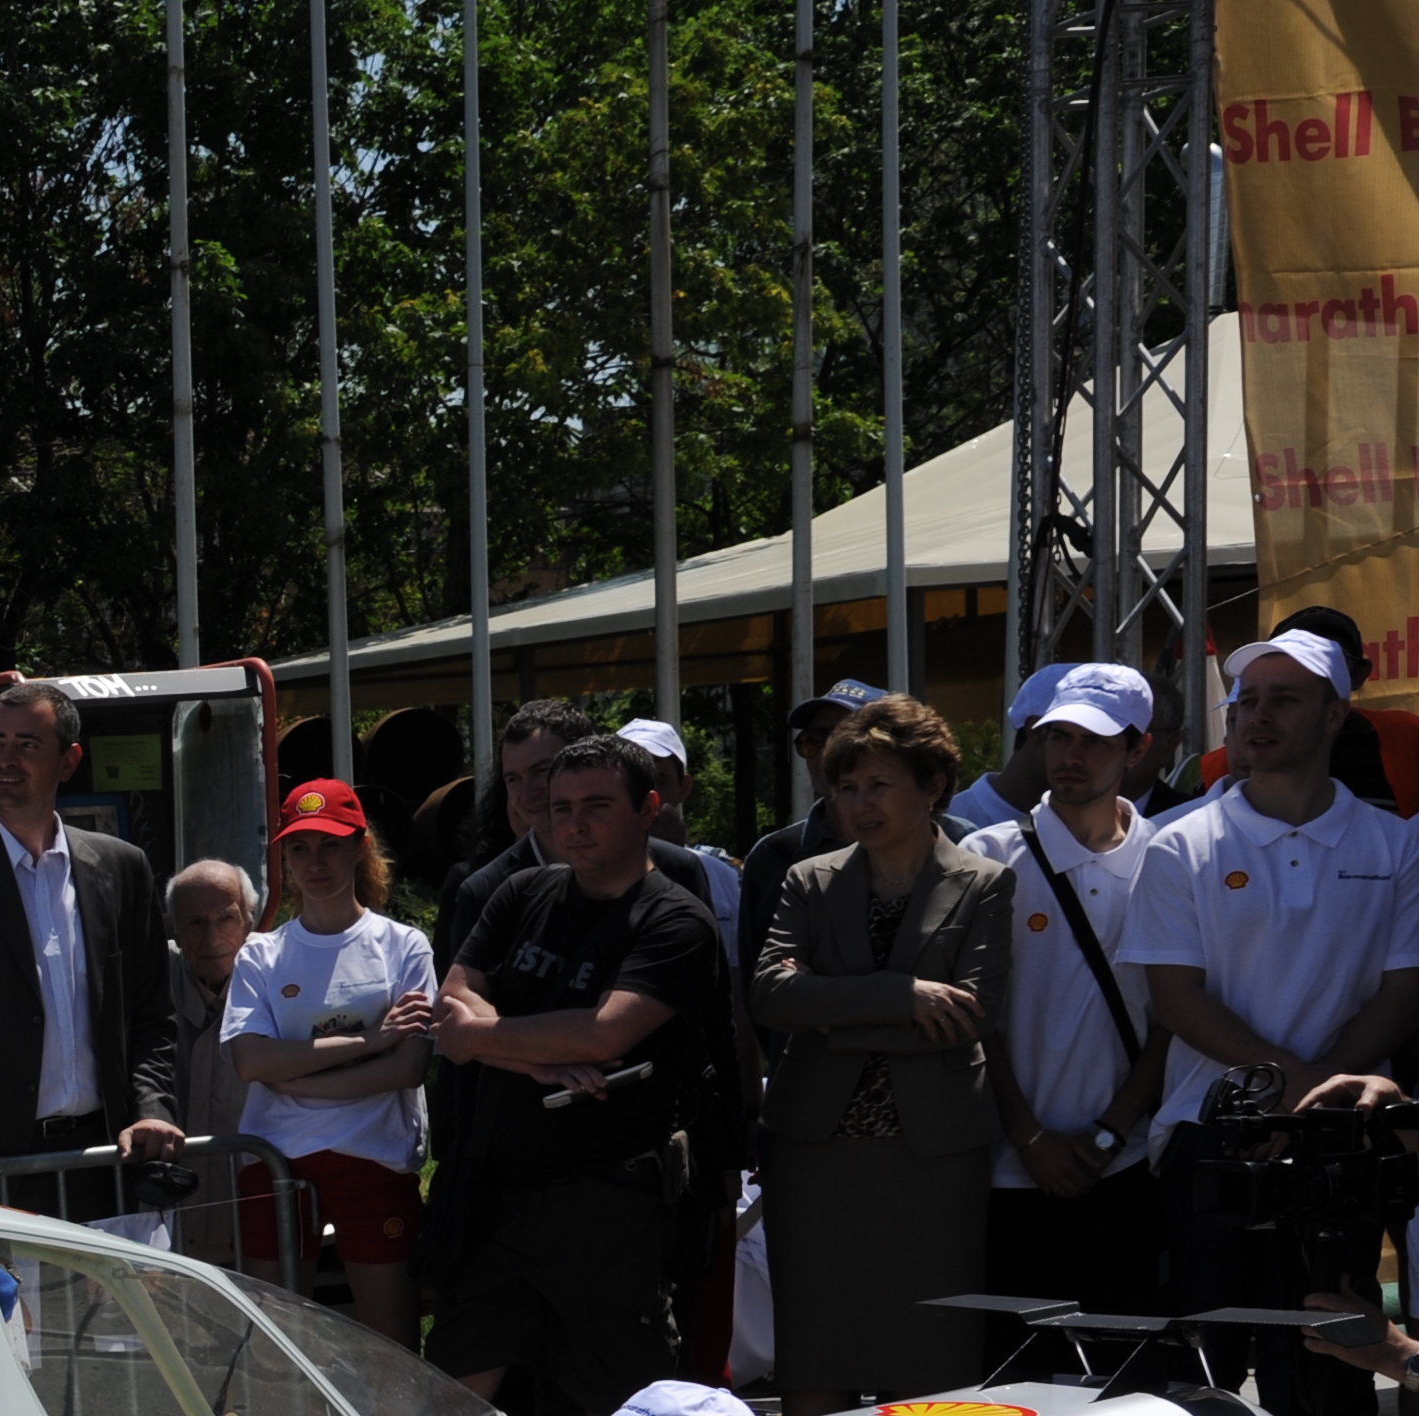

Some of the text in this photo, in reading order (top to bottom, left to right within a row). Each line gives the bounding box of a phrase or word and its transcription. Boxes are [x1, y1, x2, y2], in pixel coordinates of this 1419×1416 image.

[1223, 90, 1372, 165] Shell
[1256, 442, 1395, 512] Shell
[512, 941, 595, 990] iSTE
